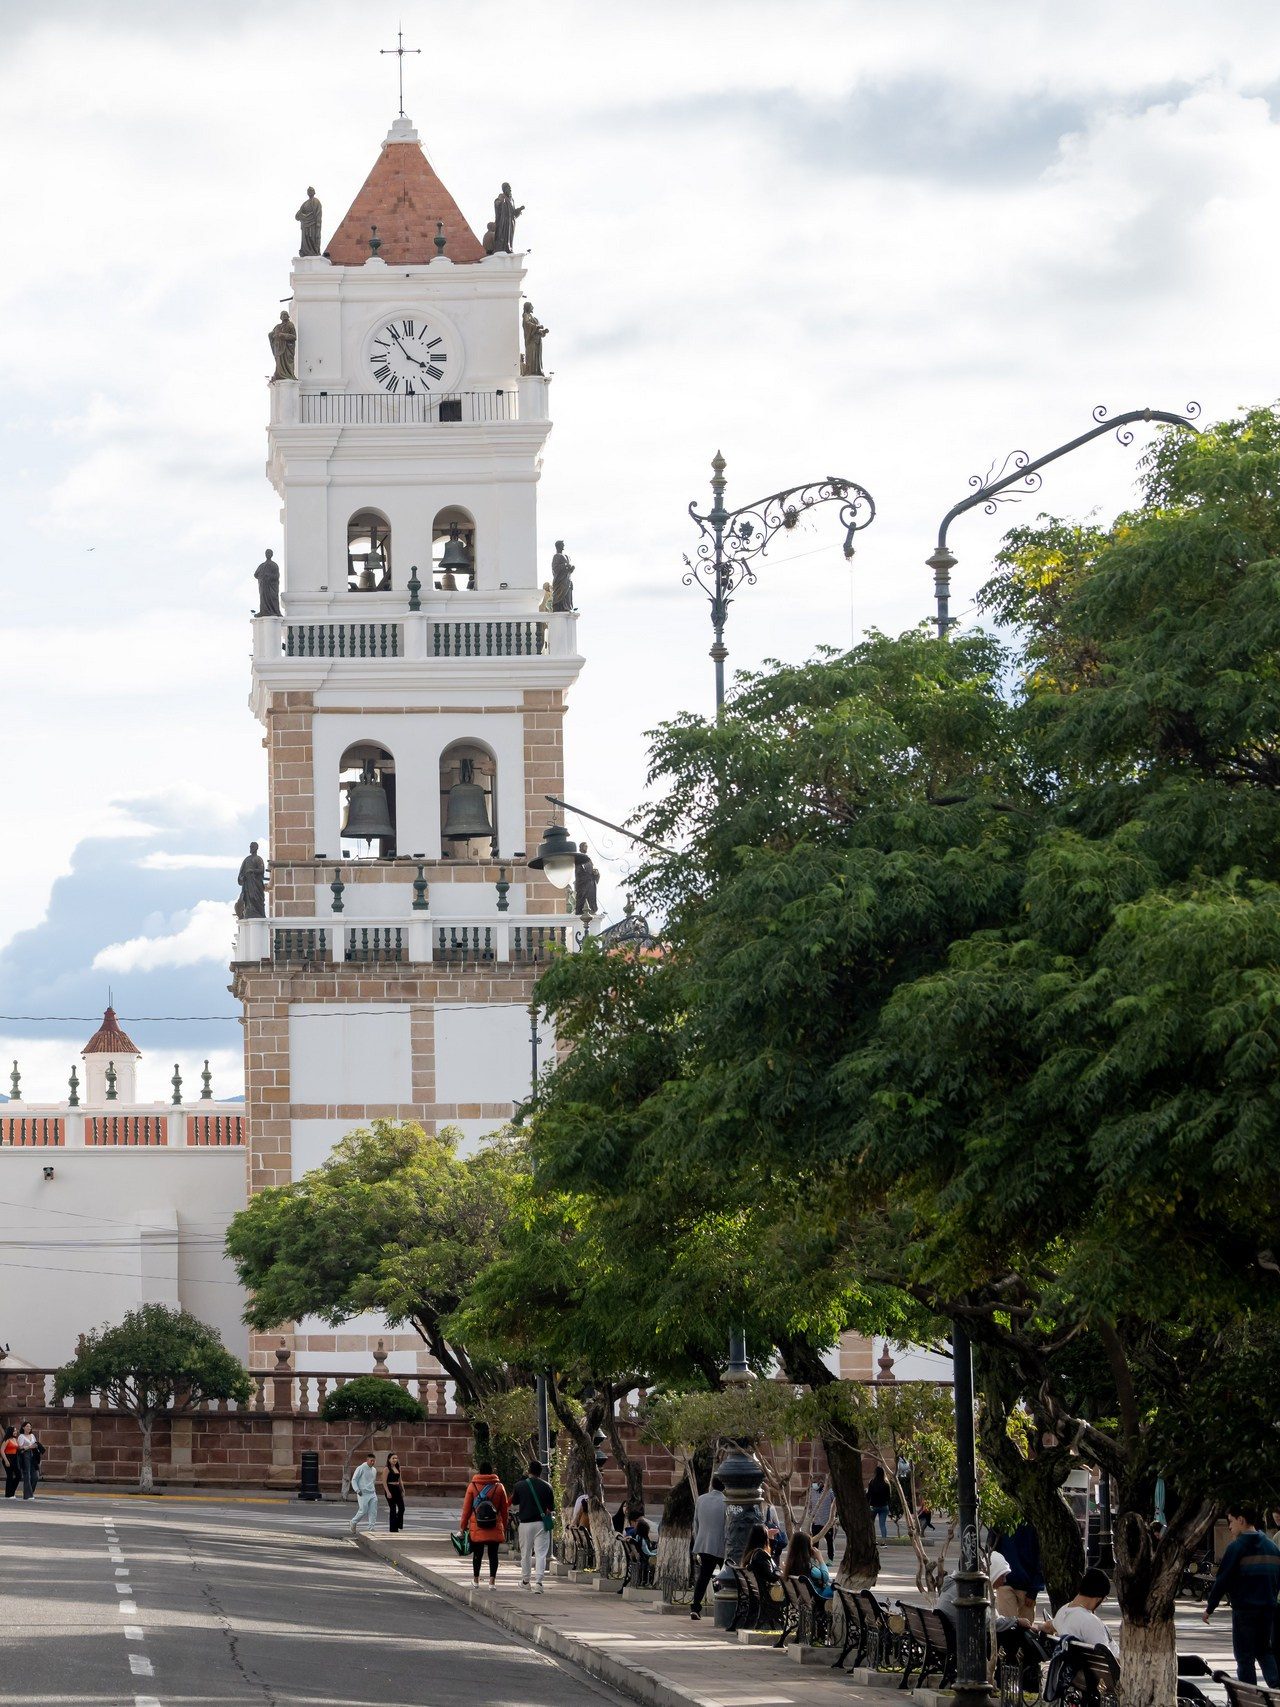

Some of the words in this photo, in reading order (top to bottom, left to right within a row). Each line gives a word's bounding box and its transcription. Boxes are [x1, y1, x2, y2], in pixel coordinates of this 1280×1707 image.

[402, 320, 414, 337] XII
[426, 337, 442, 349] II
[430, 354, 447, 362] III
